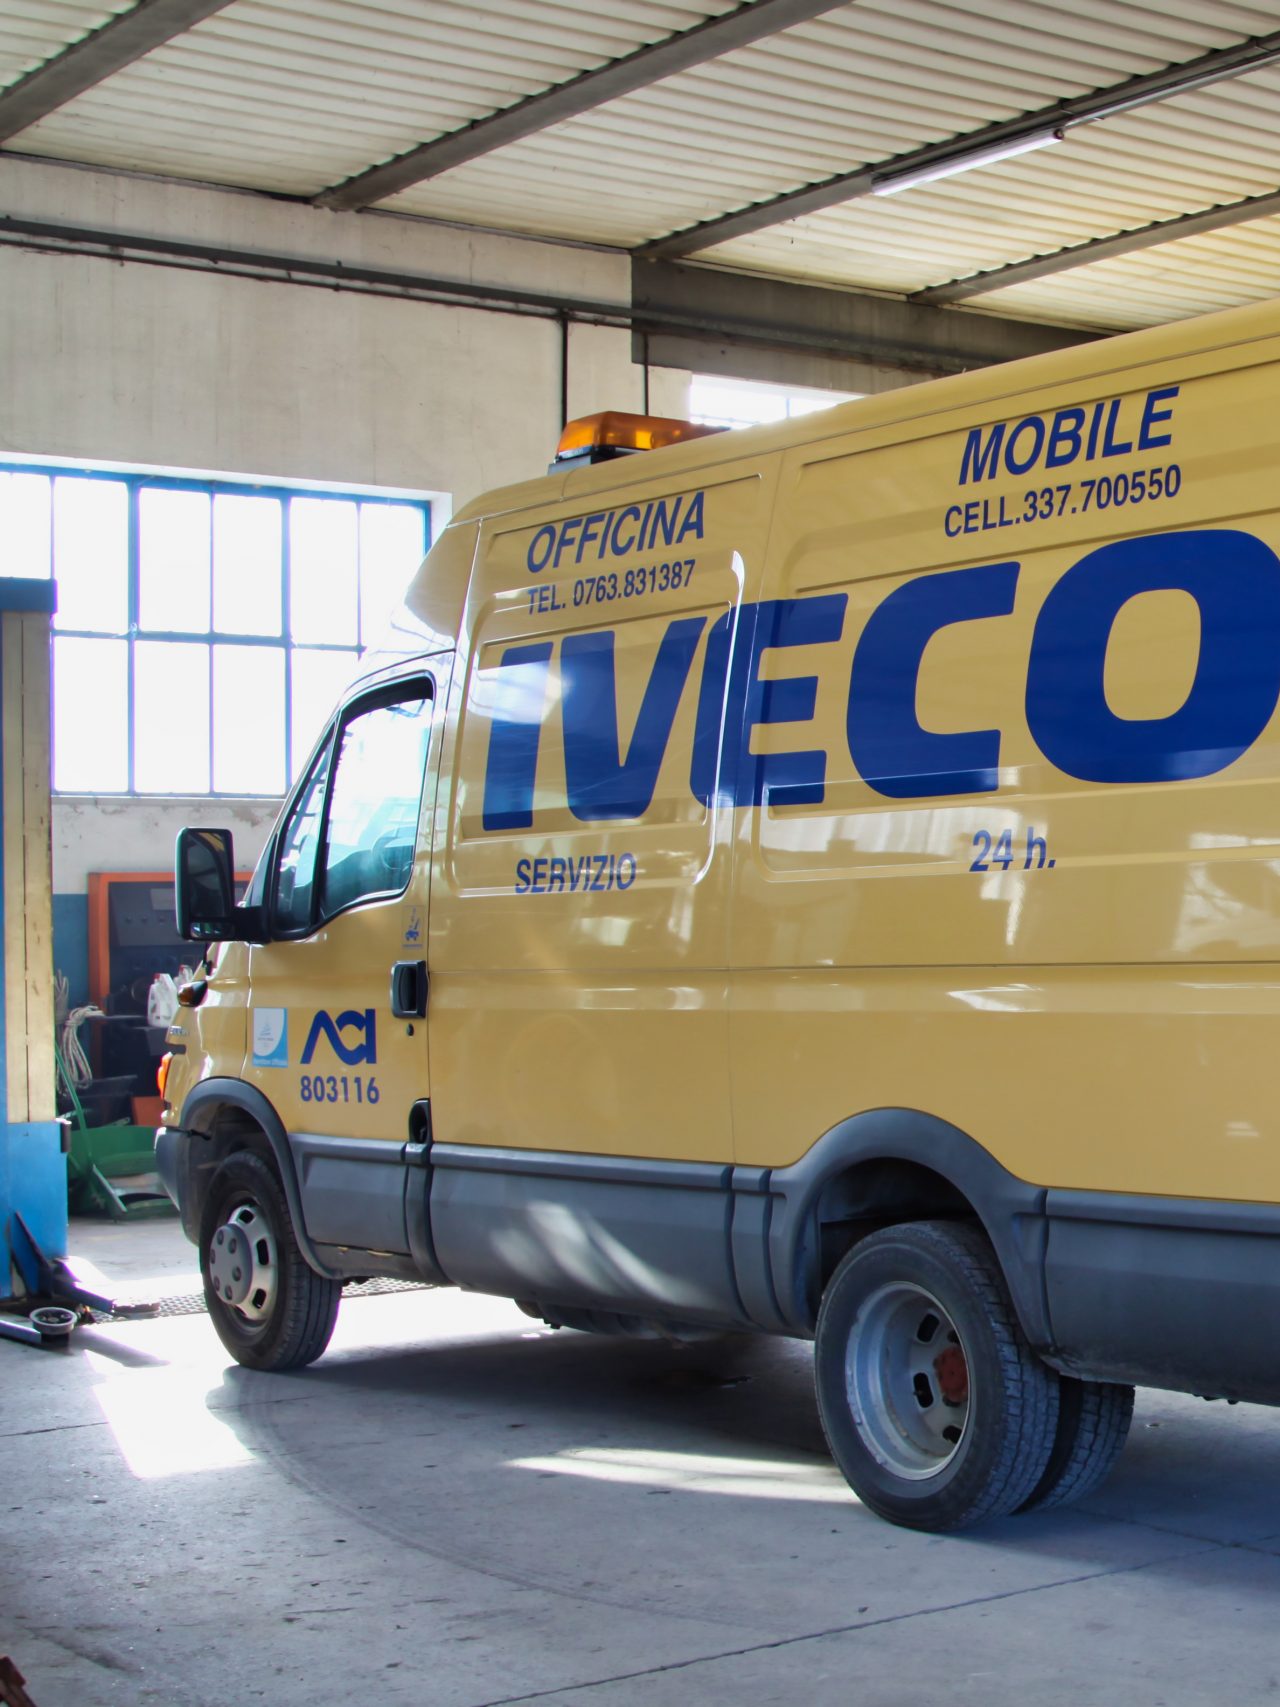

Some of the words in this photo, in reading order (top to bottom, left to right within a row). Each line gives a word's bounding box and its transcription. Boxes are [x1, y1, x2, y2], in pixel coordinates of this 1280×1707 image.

[958, 386, 1180, 486] MOBILE
[944, 464, 1182, 537] CELL.337.700550
[526, 491, 705, 573] OFFICINA
[527, 584, 566, 615] TEL.
[573, 559, 696, 607] 0763.831387
[515, 852, 637, 894] SERVIZIO
[969, 829, 1014, 872] 24
[1023, 826, 1056, 870] h.
[300, 1008, 377, 1066] ACI
[300, 1075, 380, 1104] 803116
